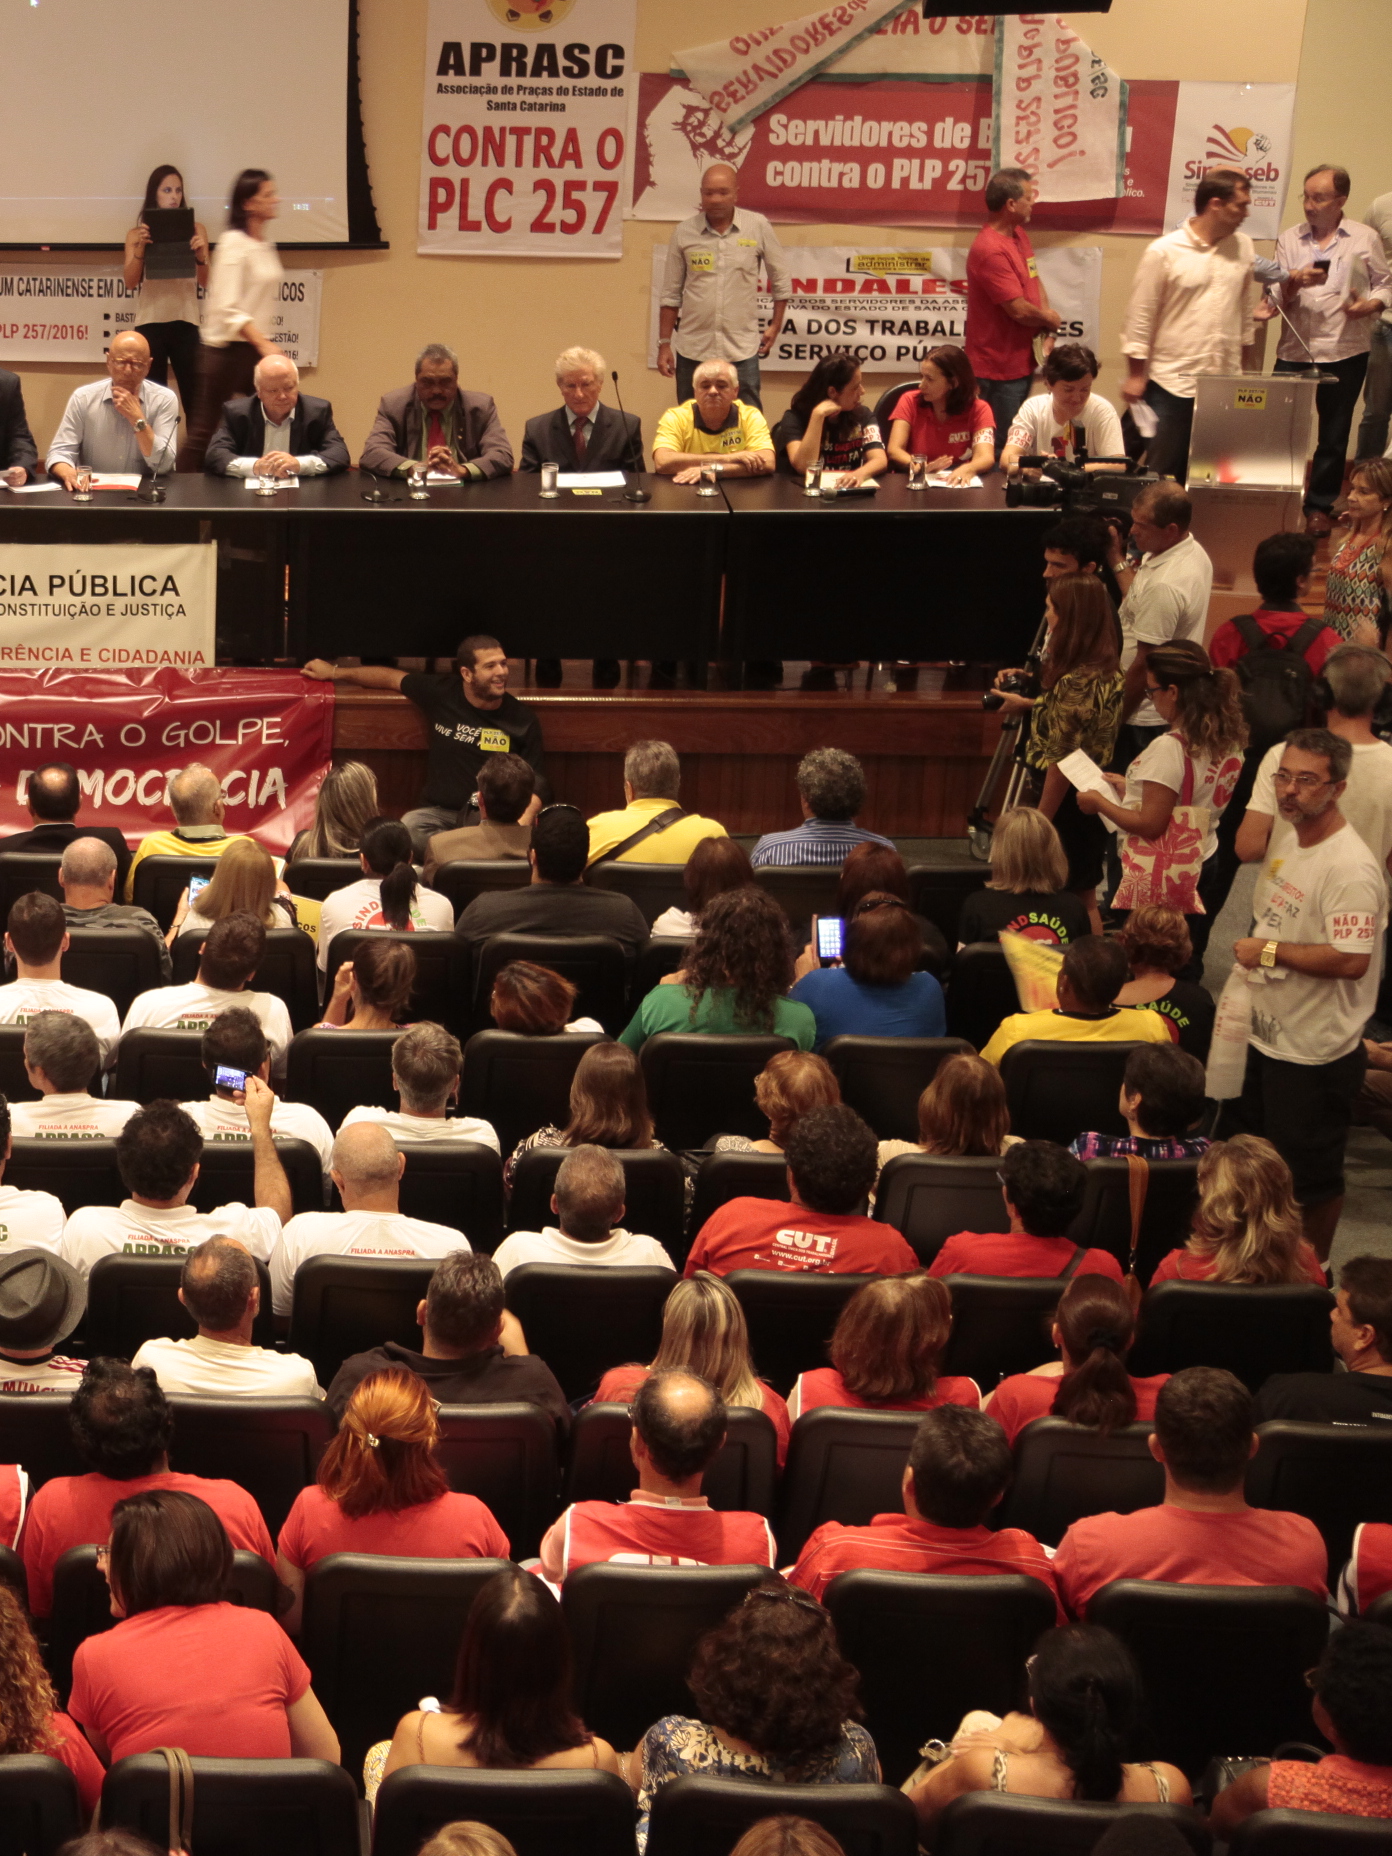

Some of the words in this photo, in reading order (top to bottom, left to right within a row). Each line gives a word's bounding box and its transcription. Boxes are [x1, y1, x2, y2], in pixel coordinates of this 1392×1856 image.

[436, 41, 625, 80] APRASC
[437, 83, 498, 97] Associação
[501, 83, 514, 95] de
[517, 84, 554, 98] Praças
[556, 85, 569, 96] do
[572, 85, 608, 97] Estado
[610, 86, 624, 98] de
[487, 100, 517, 111] Santa
[520, 100, 566, 113] Catarina
[768, 114, 927, 149] Servidores
[933, 118, 971, 149] de
[428, 123, 583, 169] CONTRA
[596, 127, 624, 170] O
[766, 159, 860, 189] contra
[867, 165, 885, 189] o
[891, 158, 942, 191] PLP
[427, 177, 514, 234] PLC
[530, 178, 619, 235] 257
[857, 259, 927, 268] administrar
[17, 277, 94, 298] CATARINENSE
[97, 279, 114, 298] EM
[23, 324, 88, 341] 257/2016!
[807, 318, 857, 336] DOS
[1238, 394, 1262, 403] NÃO
[722, 435, 741, 447] NÃO
[48, 569, 180, 597] PÚBLICA
[106, 602, 116, 616] E
[120, 602, 187, 620] JUSTIÇA
[80, 648, 91, 661] E
[98, 648, 205, 665] CIDADANIA
[120, 723, 146, 747] O
[162, 717, 290, 747] GOLPE,
[435, 723, 452, 737] VIVE
[453, 732, 475, 744] SEM
[484, 735, 506, 746] NÃO
[1333, 914, 1358, 927] NÃO
[1333, 929, 1354, 939] PLP
[776, 1229, 832, 1252] CUT
